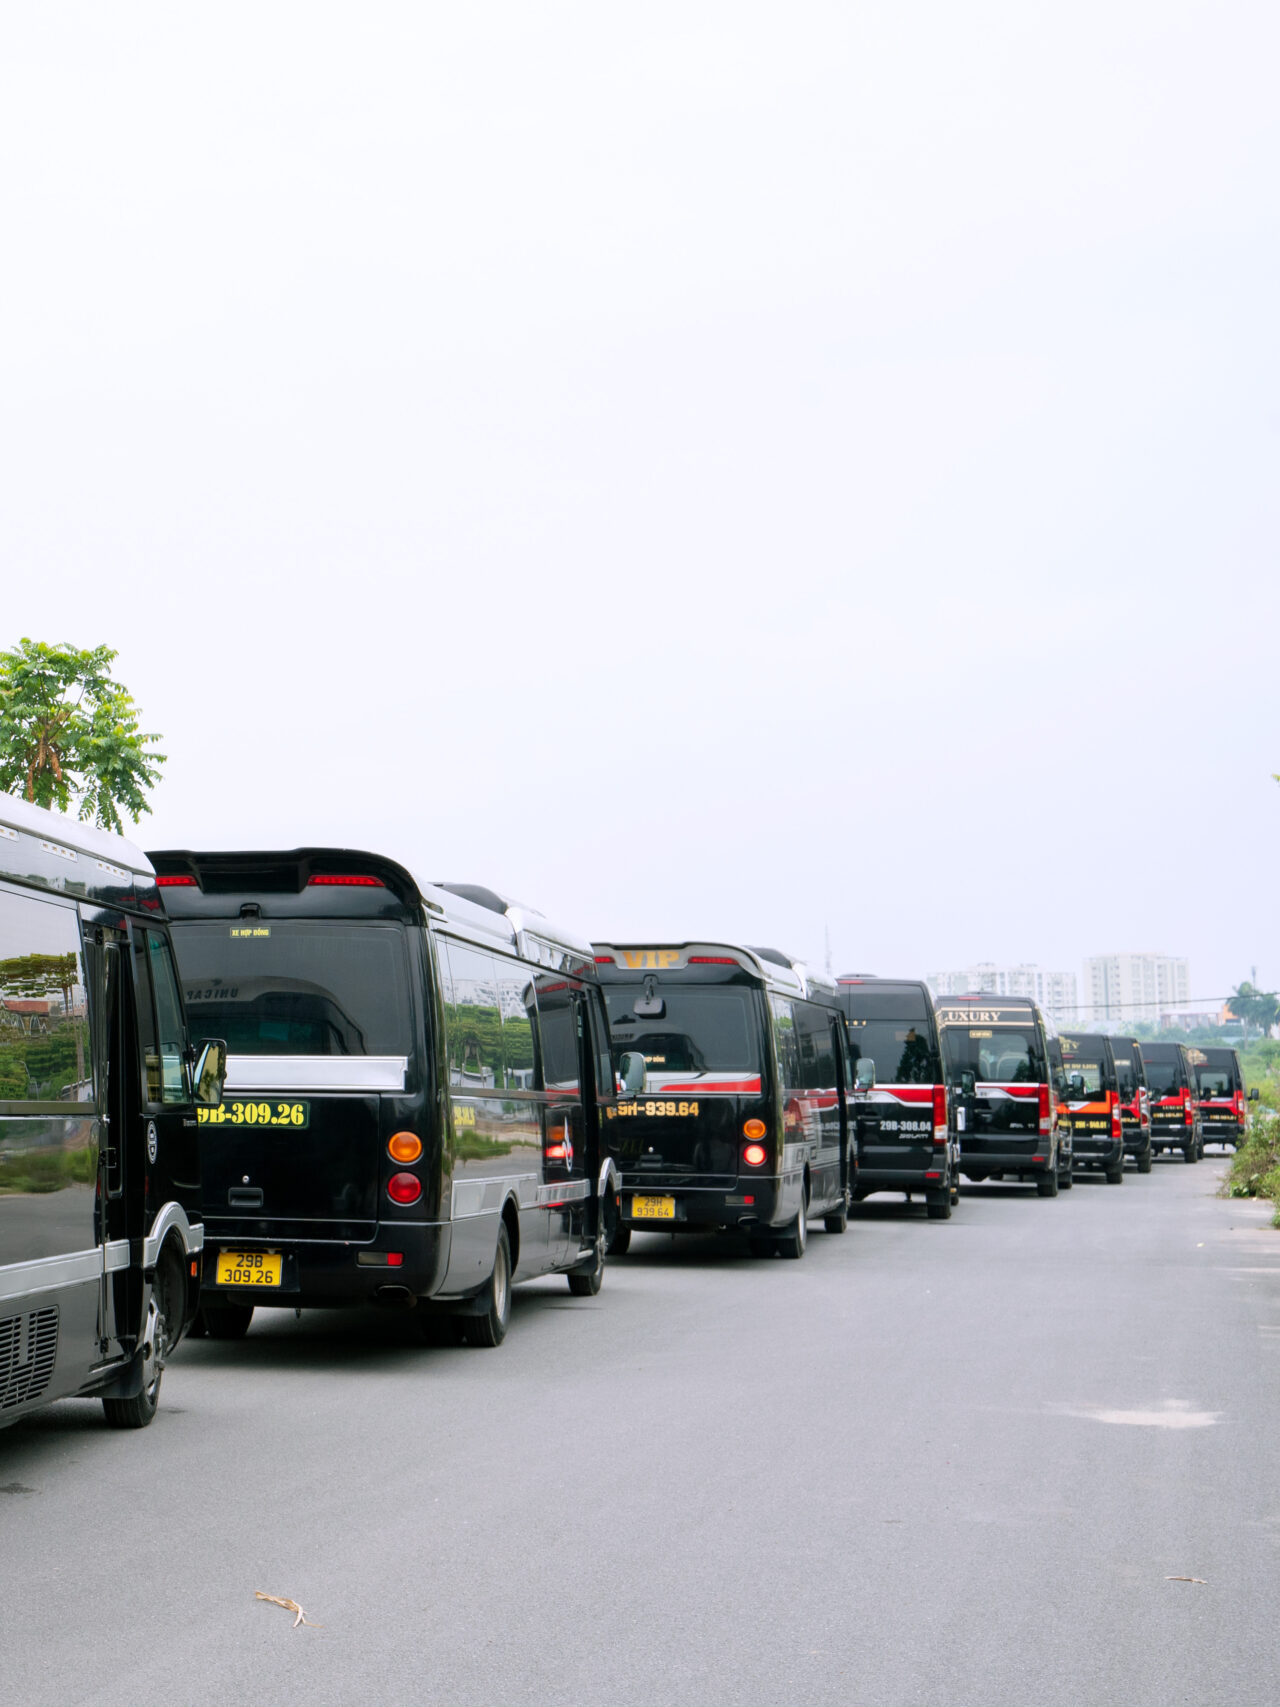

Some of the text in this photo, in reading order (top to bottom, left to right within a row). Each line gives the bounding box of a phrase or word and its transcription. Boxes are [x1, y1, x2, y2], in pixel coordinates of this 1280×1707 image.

[622, 951, 680, 969] VIP
[197, 1102, 305, 1126] 9B-309.26
[617, 1101, 700, 1117] 9H-939.64
[236, 1254, 263, 1268] 29B
[224, 1269, 273, 1284] 309.26
